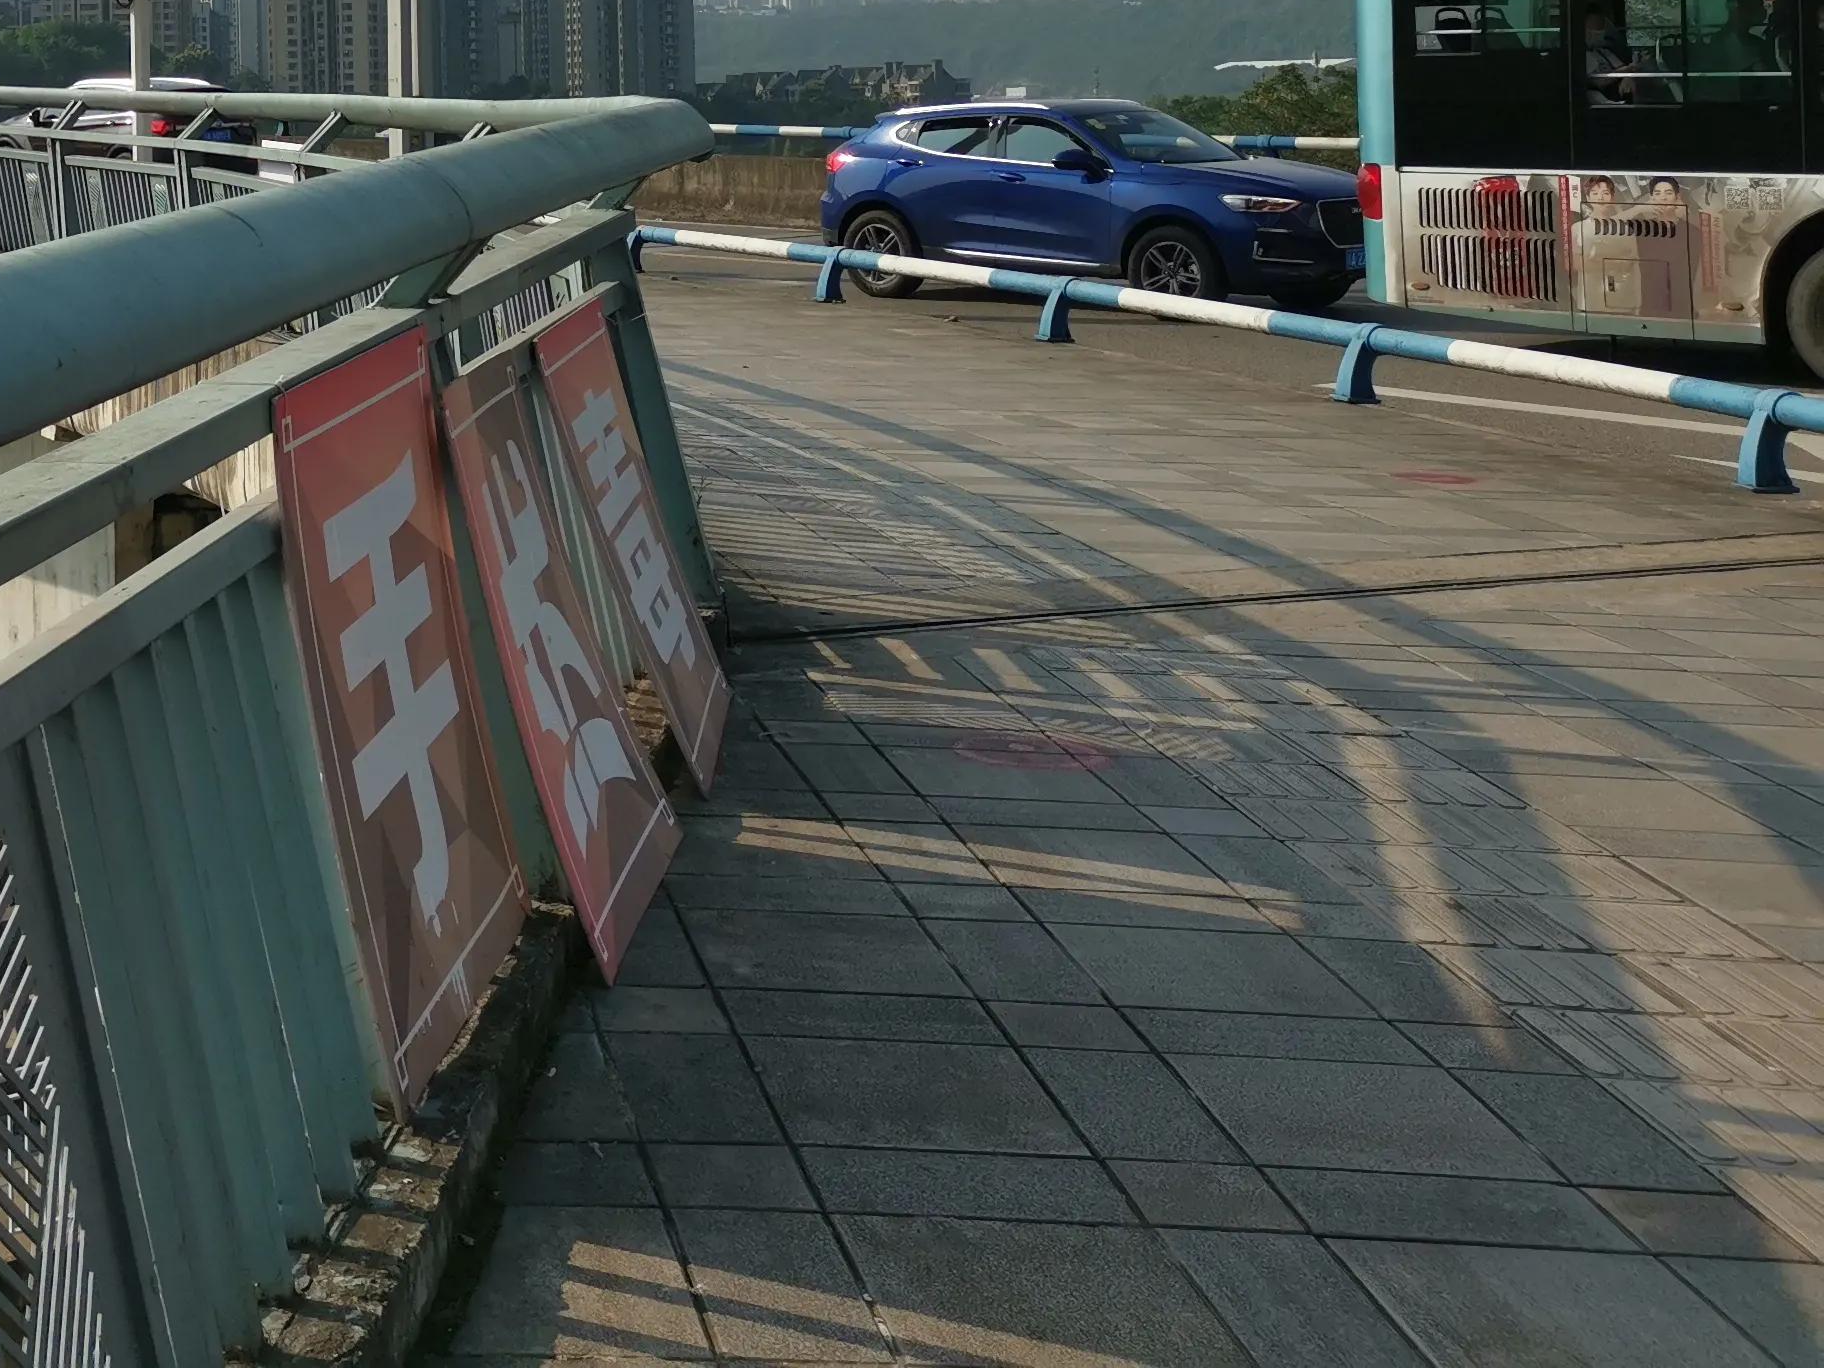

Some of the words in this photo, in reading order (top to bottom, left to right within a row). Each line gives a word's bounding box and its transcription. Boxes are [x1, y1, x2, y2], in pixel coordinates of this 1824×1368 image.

[323, 450, 460, 934] 手
[482, 439, 636, 862] 洗
[572, 388, 696, 670] 毒
